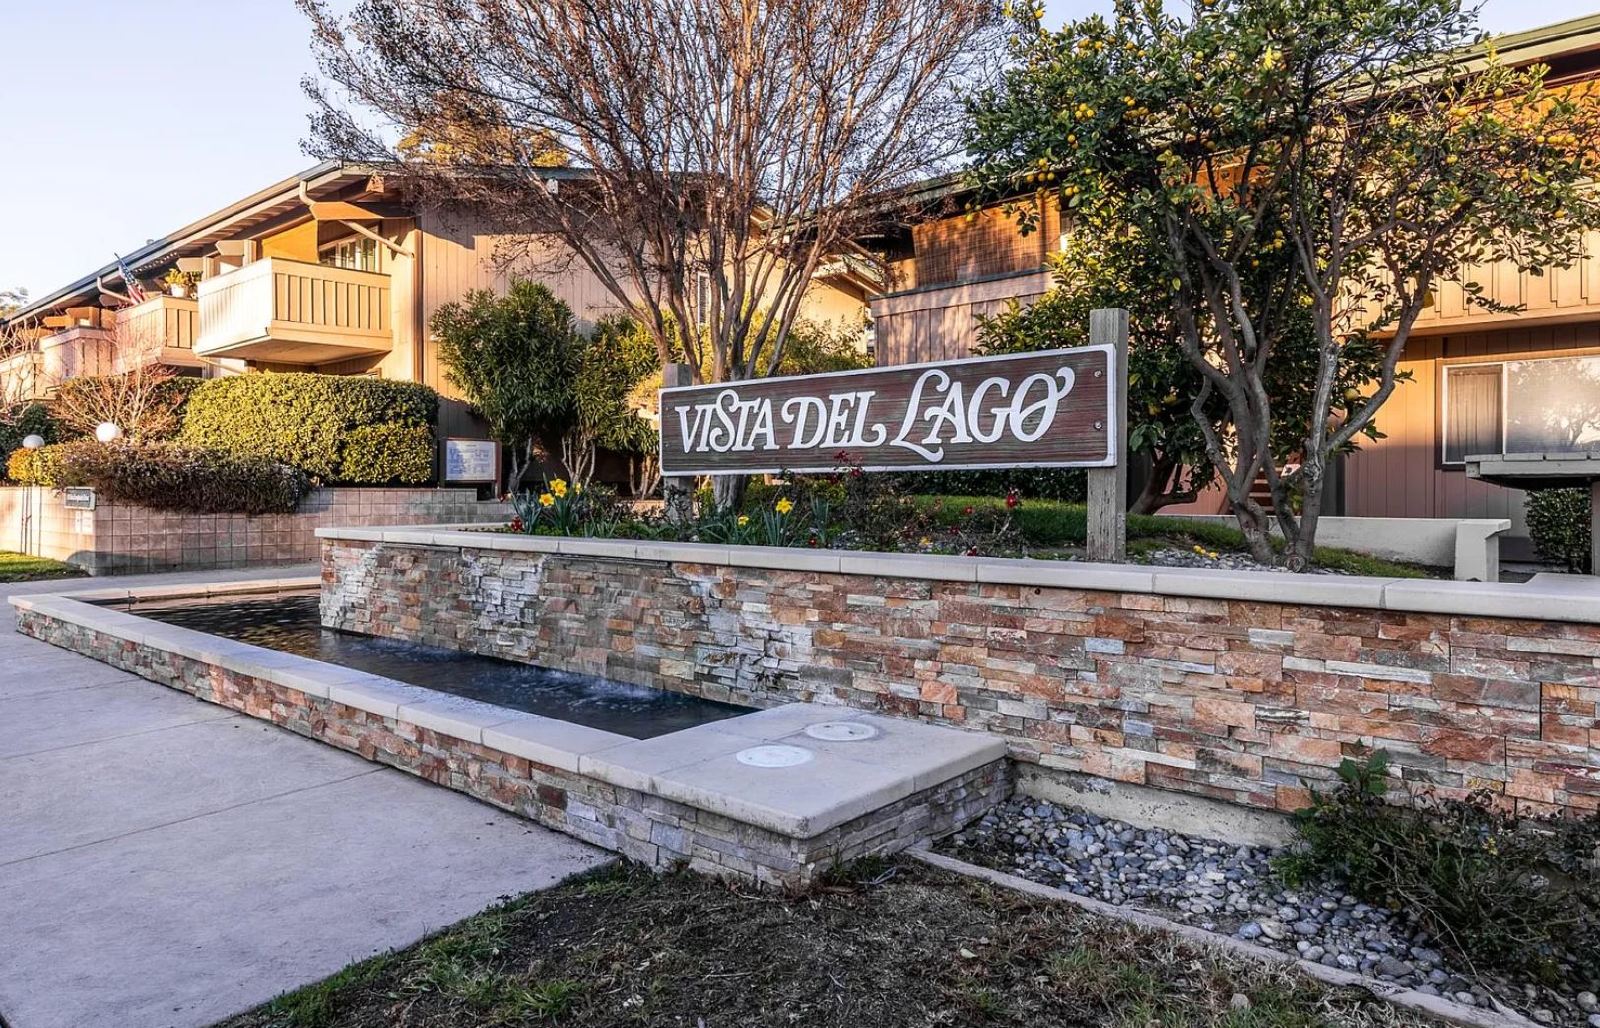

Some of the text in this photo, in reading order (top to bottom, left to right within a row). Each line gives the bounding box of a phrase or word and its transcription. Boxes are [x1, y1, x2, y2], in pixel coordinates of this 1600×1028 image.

[675, 368, 1075, 462] VISTA DEL LAGO
